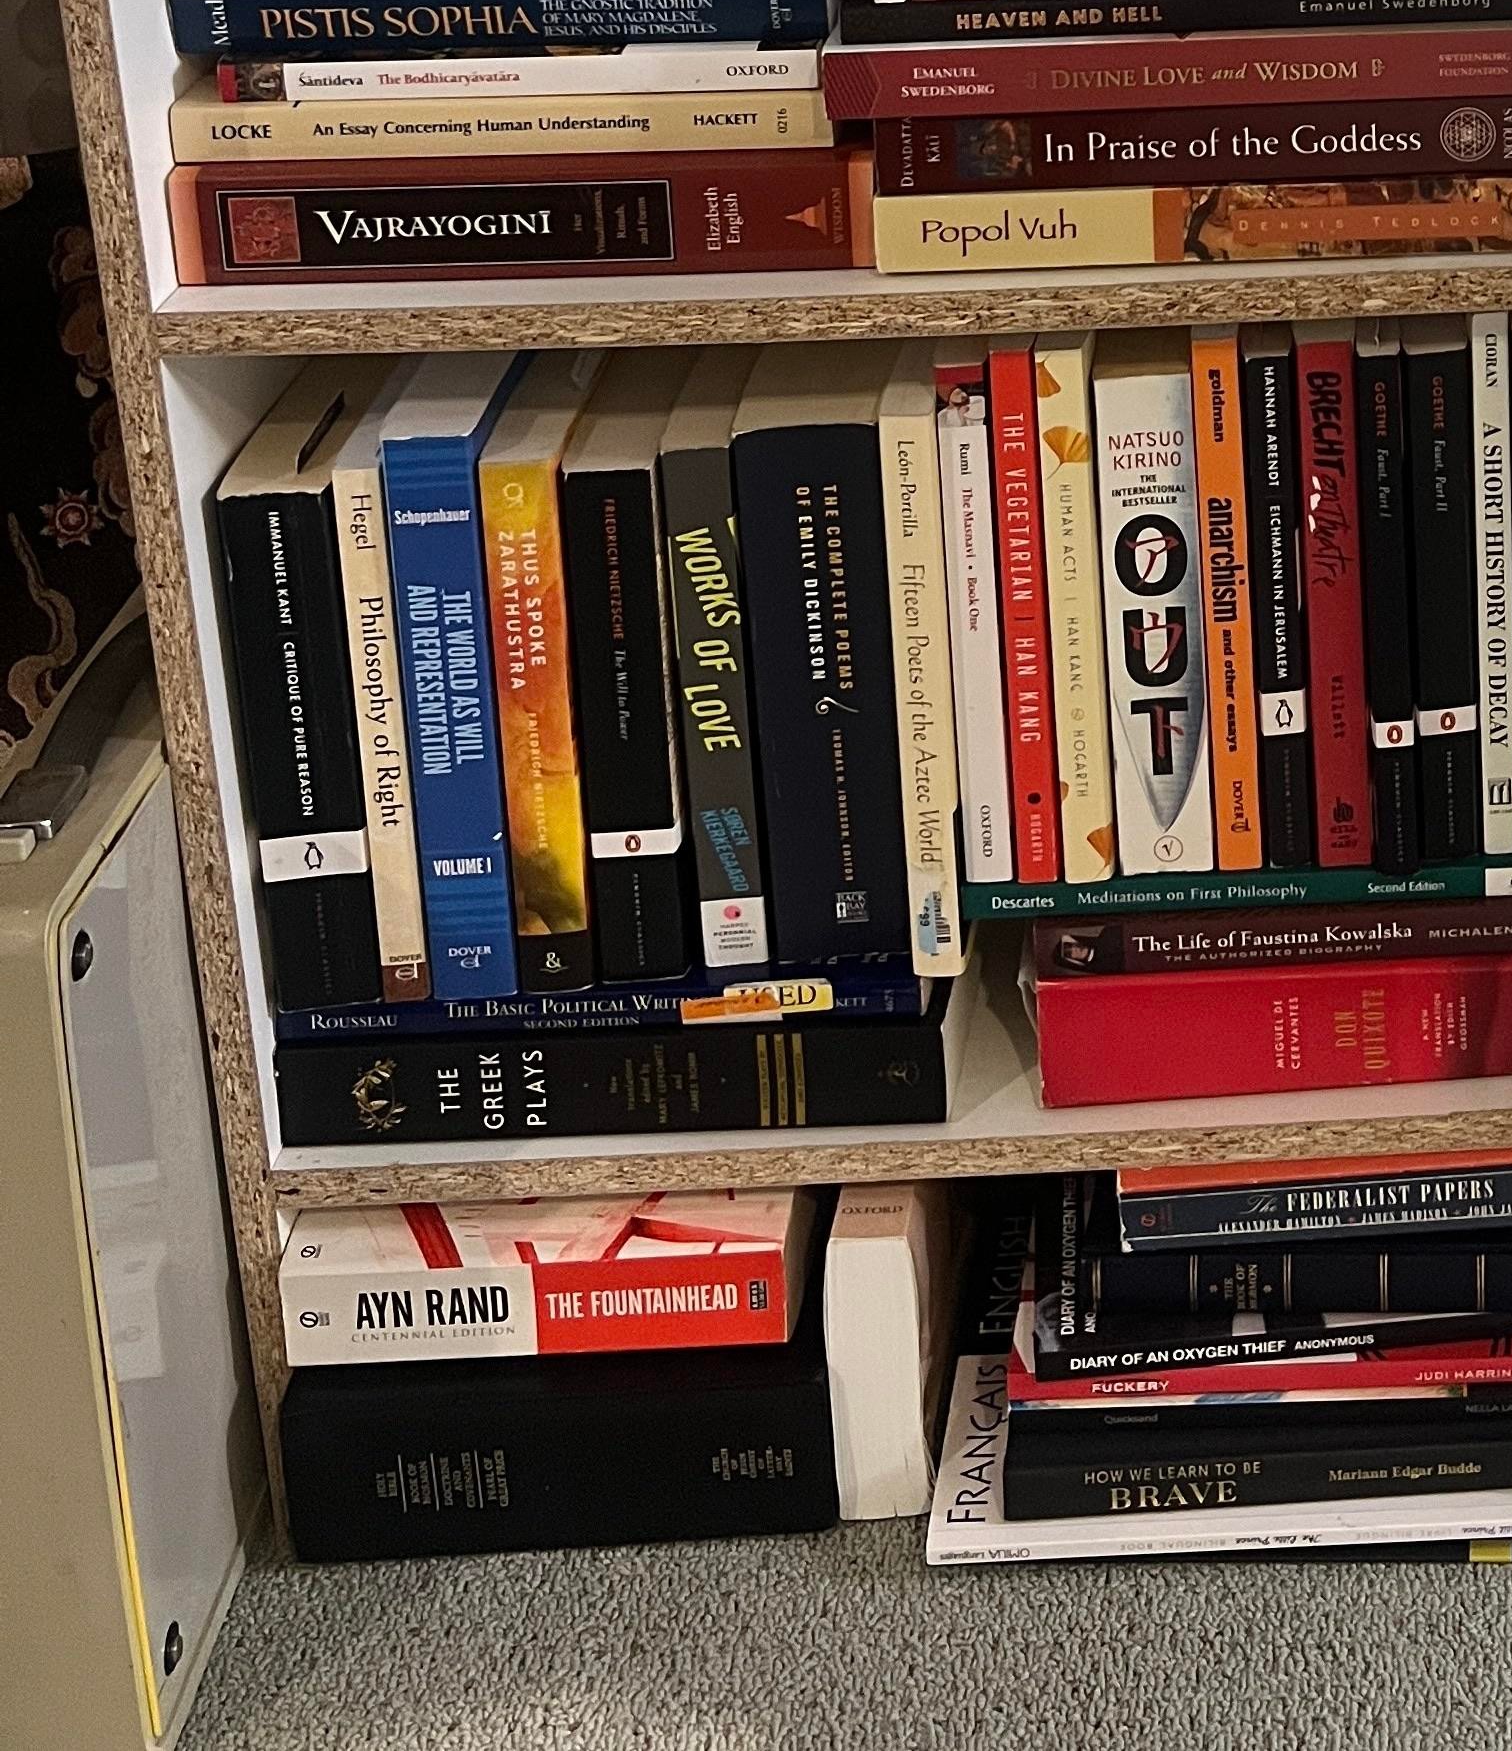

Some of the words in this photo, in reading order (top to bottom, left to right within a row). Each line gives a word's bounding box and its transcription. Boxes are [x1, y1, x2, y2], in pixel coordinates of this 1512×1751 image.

[259, 8, 375, 41] PISTIS
[381, 5, 539, 38] SOPHIA
[956, 10, 1048, 29] HEAVEN
[1055, 7, 1104, 26] AND
[1112, 5, 1163, 24] HELL
[726, 63, 789, 77] OXFORD
[211, 125, 272, 140] LOCKE
[693, 112, 758, 128] HACKETT
[1044, 134, 1073, 163] In
[1087, 131, 1177, 162] Praise
[1189, 131, 1220, 158] of
[1232, 129, 1279, 158] the
[1291, 125, 1421, 155] Goddess
[921, 210, 1009, 256] Popol
[1020, 209, 1078, 241] Vuh
[1208, 369, 1225, 443] goldman
[1108, 432, 1184, 450] NATSUO
[1483, 422, 1502, 438] A
[1113, 452, 1182, 470] KIRINO
[1484, 445, 1504, 524] SHORT
[351, 494, 377, 550] Hegel
[394, 507, 471, 526] Schopenhauer
[1207, 497, 1245, 624] anarchism
[675, 527, 741, 631] WORKS
[1485, 531, 1506, 630] HISTORY
[693, 638, 737, 674] OF
[1487, 638, 1507, 665] OF
[684, 681, 742, 751] LOVE
[1488, 674, 1508, 748] DECAY
[992, 894, 1055, 910] Descartes
[1132, 934, 1171, 952] The
[1178, 932, 1212, 952] Life
[1218, 930, 1236, 948] of
[1241, 926, 1318, 946] Faustina
[1324, 923, 1412, 943] Kowalska
[438, 1066, 460, 1114] THE
[480, 1053, 504, 1130] GREEK
[523, 1049, 547, 1126] PLAYS
[1287, 1184, 1412, 1212] FEDERALIST
[1420, 1179, 1495, 1204] PAPERS
[356, 1289, 414, 1330] AYN
[426, 1285, 509, 1325] RAND
[545, 1292, 585, 1320] THE
[591, 1283, 739, 1317] FOUNTAINHEAD
[1070, 1350, 1117, 1371] DIARY
[1119, 1349, 1141, 1366] OF
[1146, 1348, 1168, 1364] AN
[1172, 1343, 1238, 1361] OXYGEN
[1242, 1339, 1287, 1357] THIEF
[1092, 1380, 1169, 1393] FUCKERY
[1110, 1480, 1237, 1510] BRAVE
